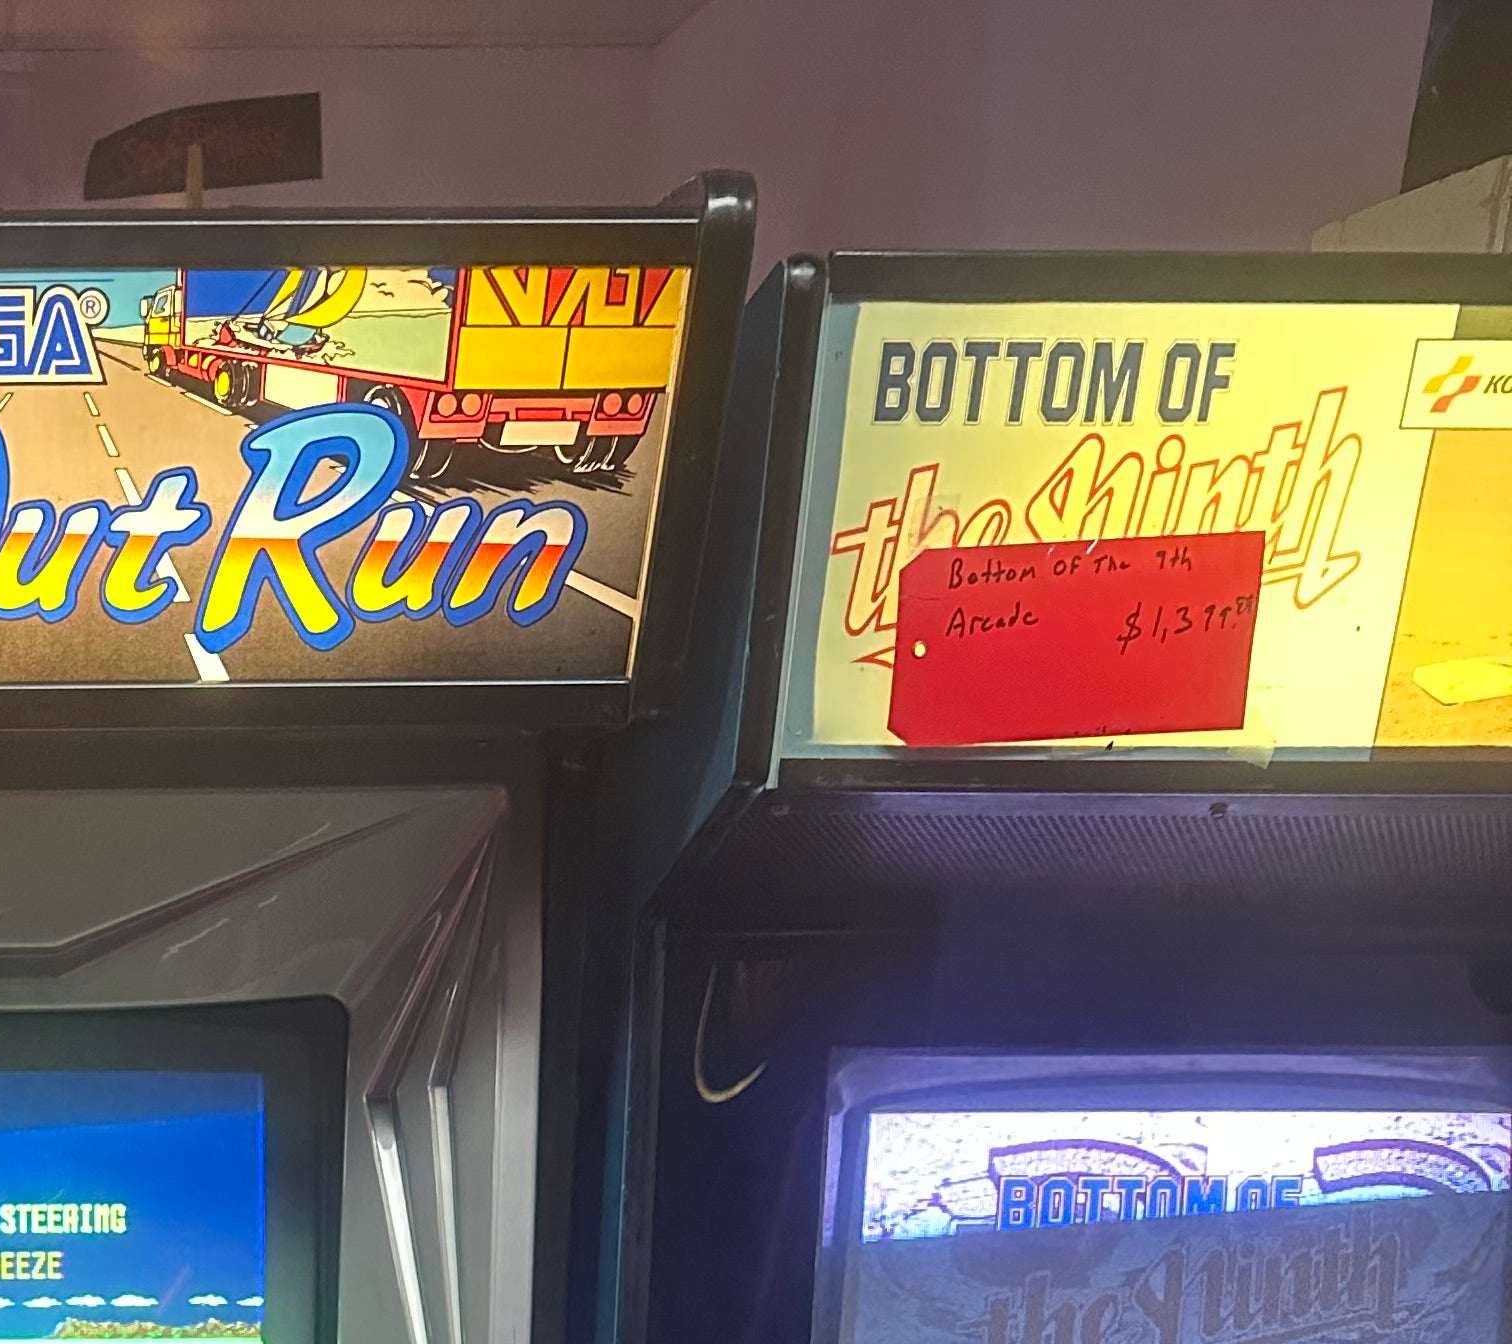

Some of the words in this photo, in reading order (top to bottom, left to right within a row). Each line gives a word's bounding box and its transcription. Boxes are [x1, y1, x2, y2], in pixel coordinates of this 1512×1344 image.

[872, 339, 1143, 425] BOTTOM
[1156, 339, 1239, 425] OF
[197, 402, 586, 652] Run
[949, 557, 1037, 590] Bottom
[1093, 554, 1131, 575] The
[1155, 546, 1192, 572] 9th
[946, 601, 1040, 638] Arcade
[0, 1203, 127, 1235] STEERING
[996, 1175, 1228, 1231] BOTTOM
